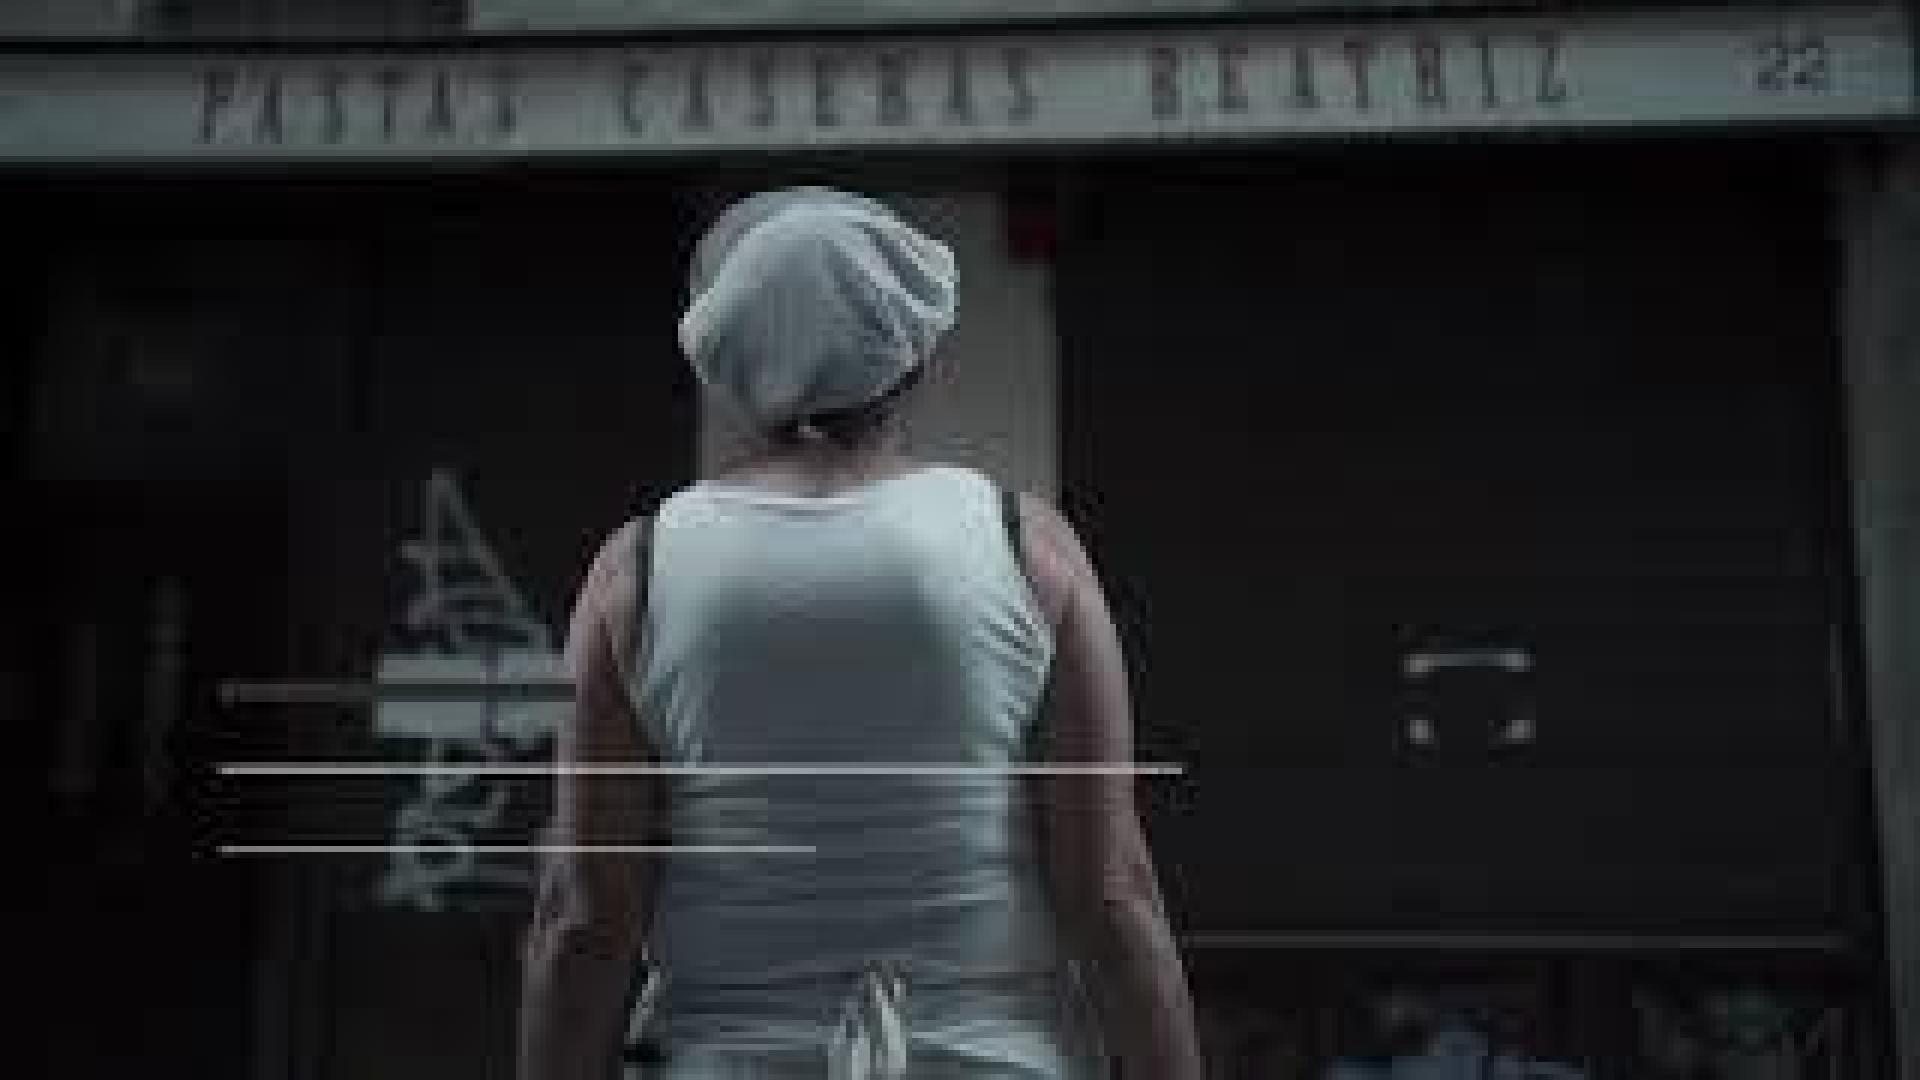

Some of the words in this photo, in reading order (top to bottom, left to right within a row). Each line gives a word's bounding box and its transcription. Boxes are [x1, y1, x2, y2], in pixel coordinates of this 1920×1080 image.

[197, 67, 521, 142] PASTAS
[622, 54, 1037, 135] CASERAS
[1151, 36, 1572, 118] BEATRIZ
[1756, 43, 1830, 93] 22
